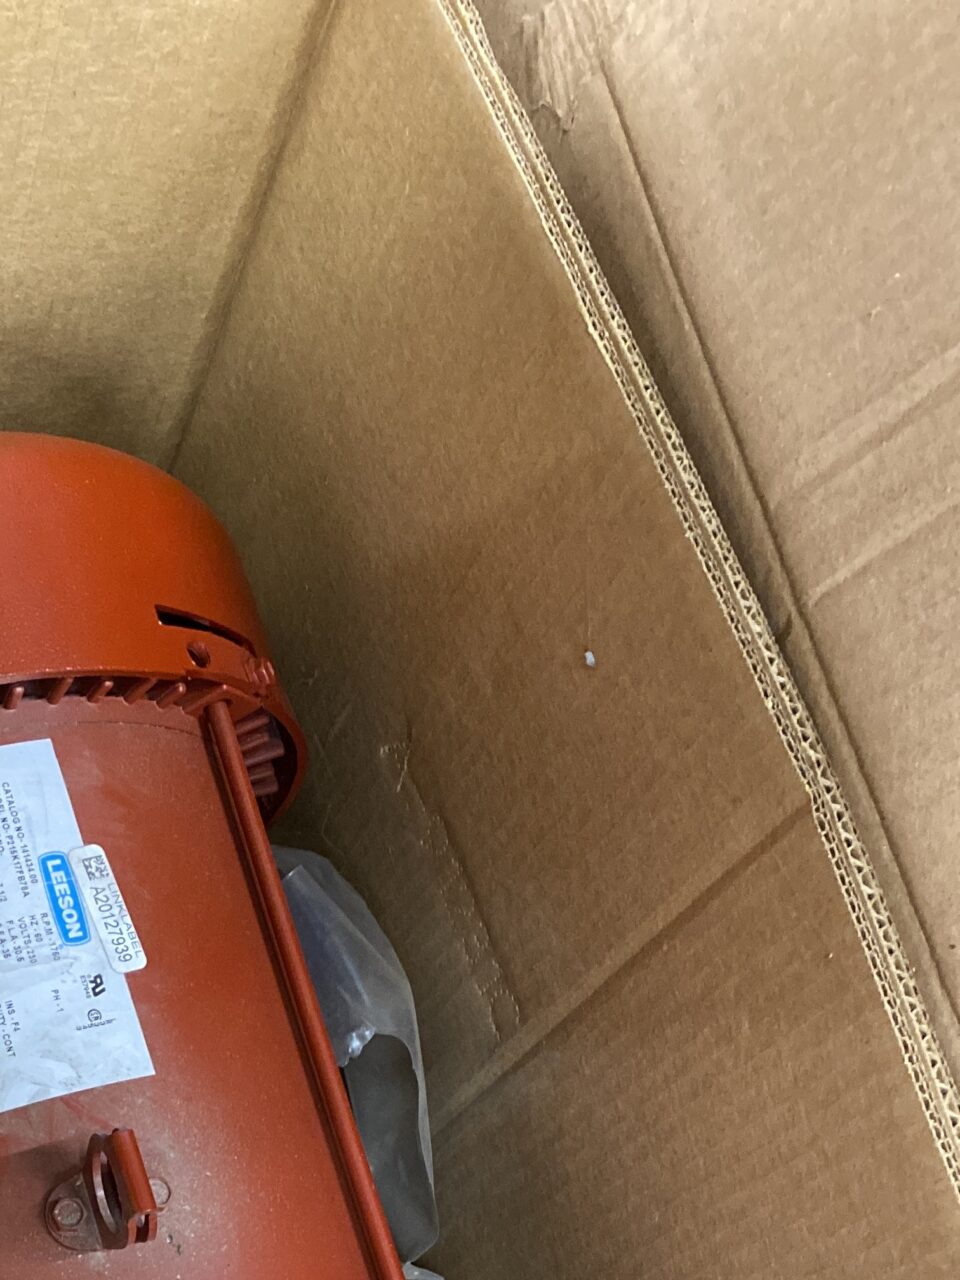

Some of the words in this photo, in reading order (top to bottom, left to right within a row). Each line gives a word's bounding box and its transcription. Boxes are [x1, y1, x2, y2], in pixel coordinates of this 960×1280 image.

[1, 781, 19, 824] CATALOG
[20, 844, 37, 884] 141434.00
[45, 857, 83, 939] LEESON
[89, 884, 133, 963] A20127939
[107, 881, 144, 958] LINKLABEL
[28, 914, 38, 926] HZ
[33, 932, 43, 943] 60
[4, 999, 15, 1015] INS
[51, 988, 60, 1000] PH
[1, 1032, 15, 1058] CONT
